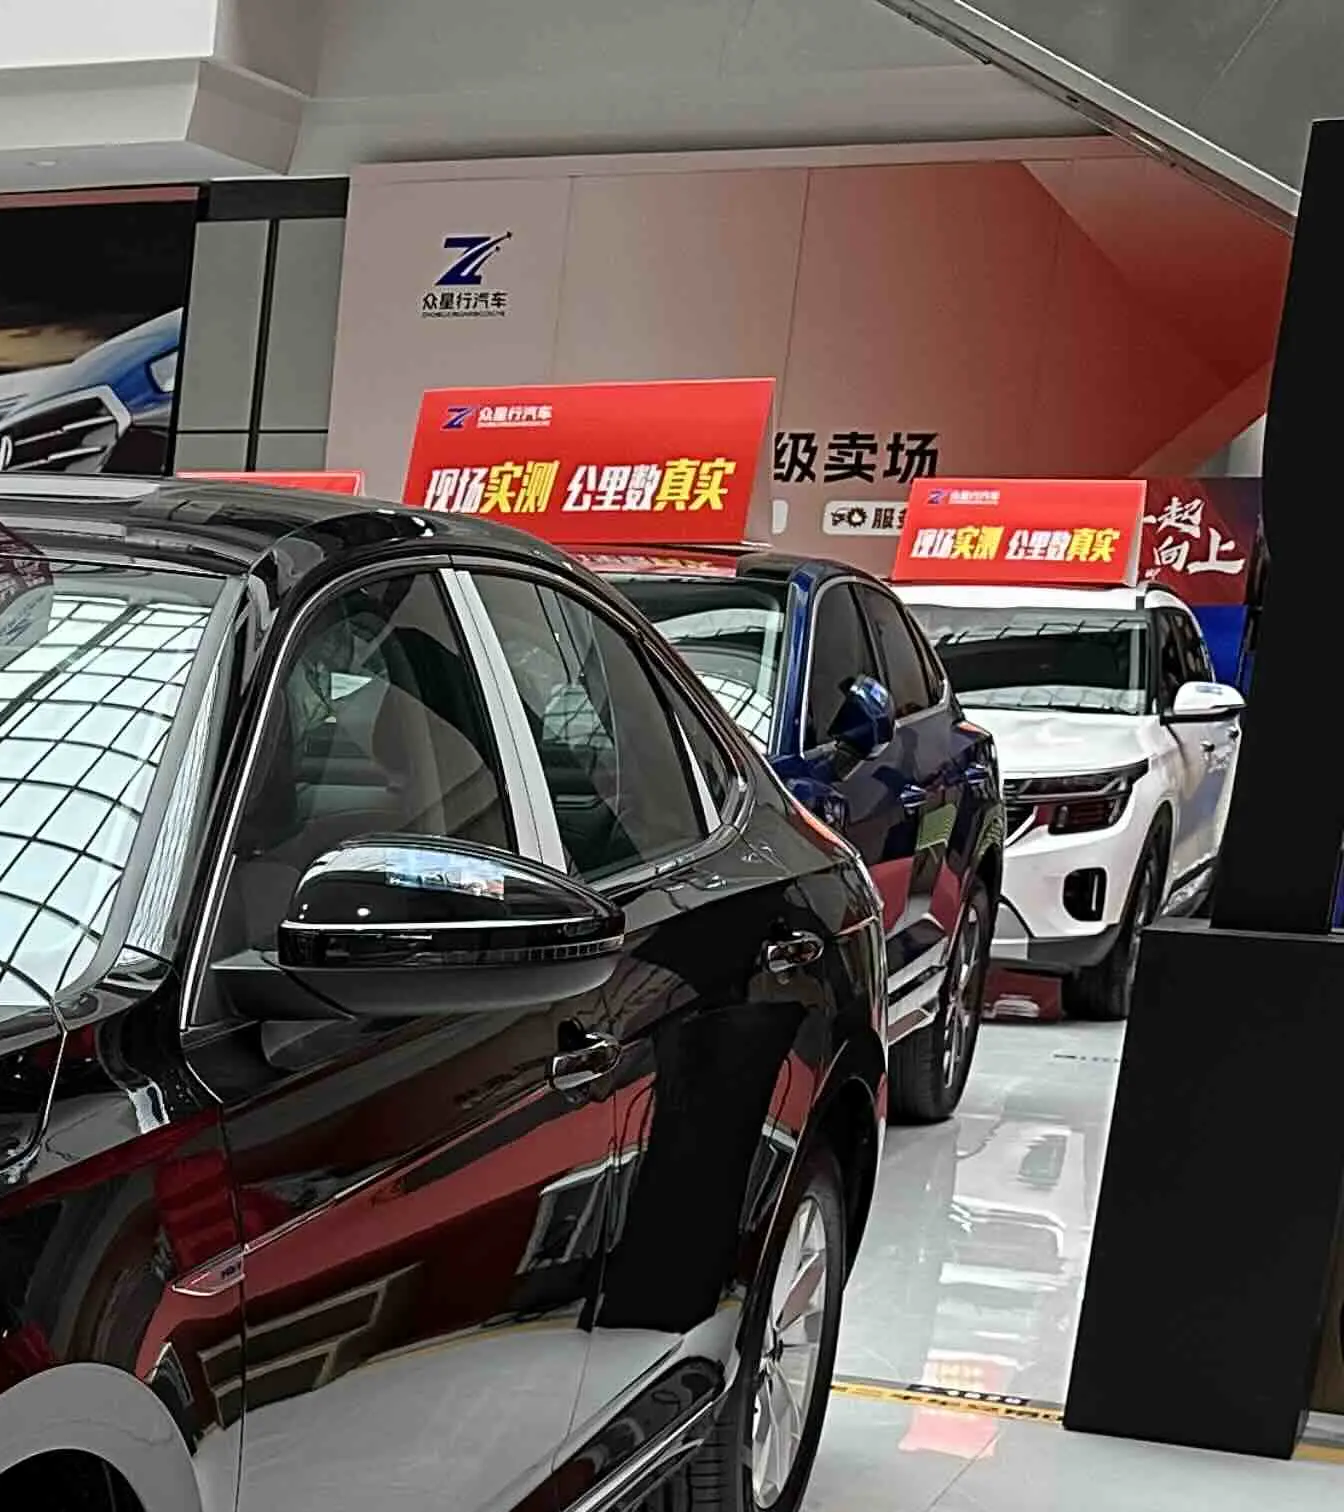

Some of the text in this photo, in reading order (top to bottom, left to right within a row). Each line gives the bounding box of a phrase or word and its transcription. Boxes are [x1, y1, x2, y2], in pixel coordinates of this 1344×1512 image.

[422, 292, 508, 310] 众星行汽车
[423, 457, 737, 513] 现场实测 公里数真实
[911, 526, 1120, 561] 现场实测 公里数真实
[1153, 526, 1246, 576] 向上
